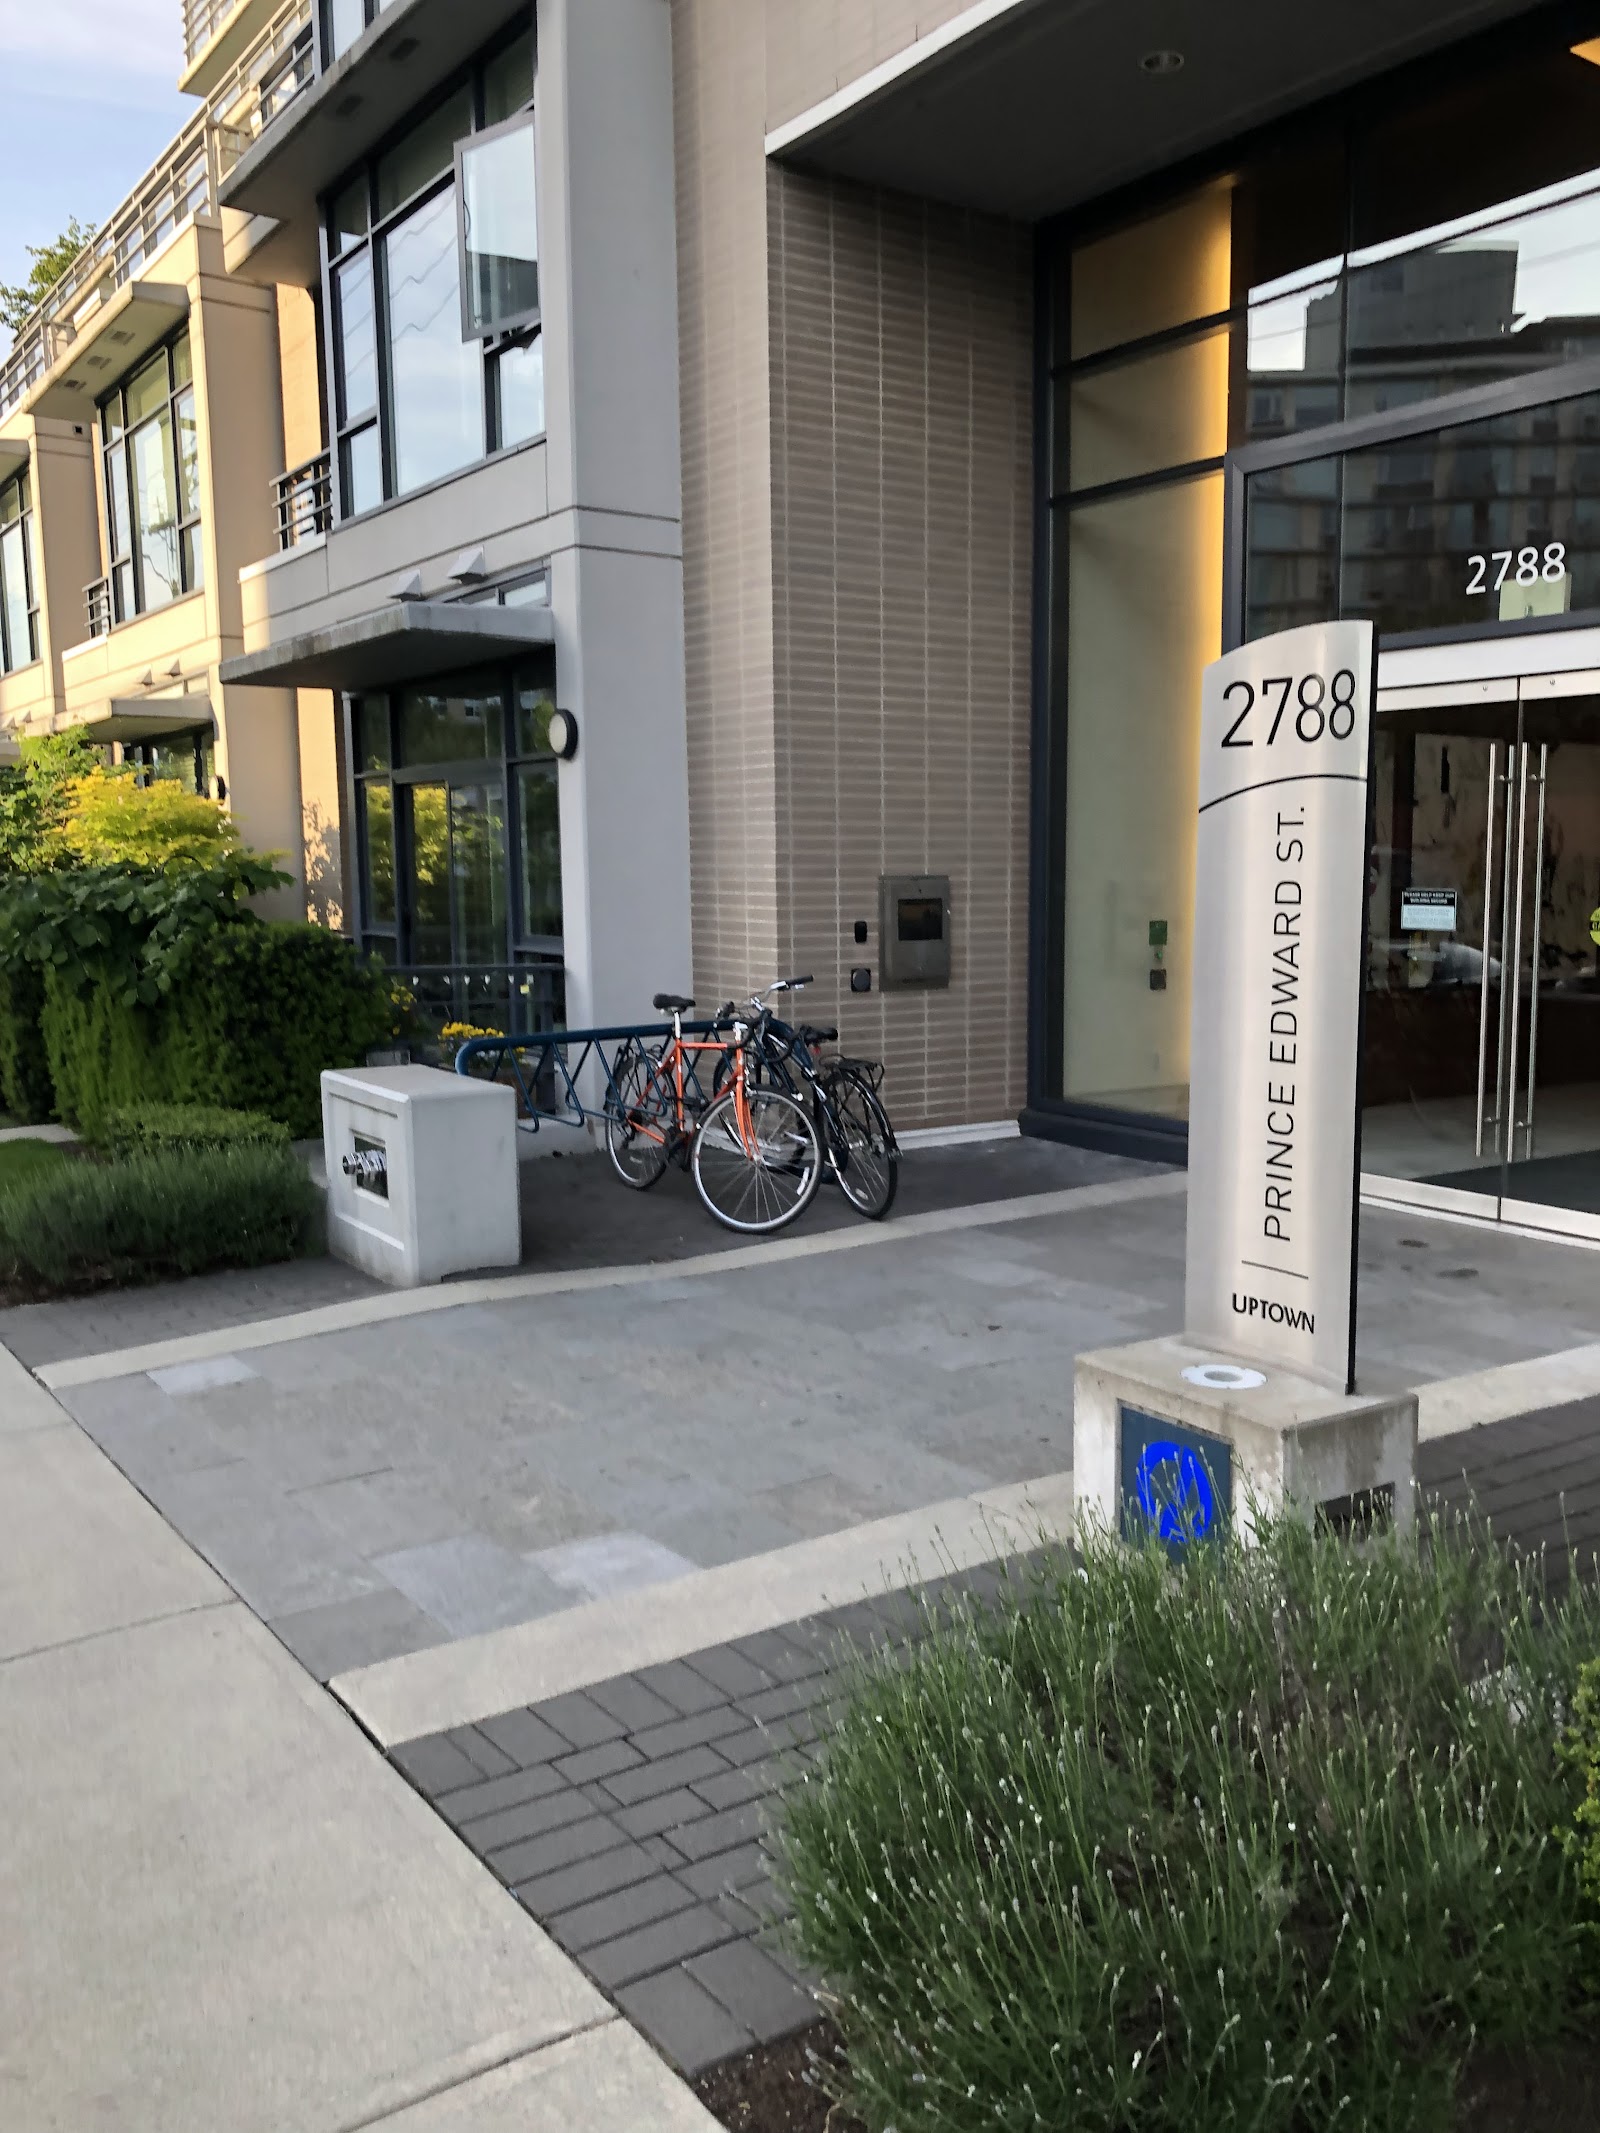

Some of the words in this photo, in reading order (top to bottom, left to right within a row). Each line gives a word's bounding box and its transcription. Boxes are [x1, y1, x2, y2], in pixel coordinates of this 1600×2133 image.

[1465, 542, 1566, 595] 2788
[1221, 669, 1355, 748] 2788
[1276, 808, 1304, 862] ST.
[1270, 881, 1301, 1064] EDWARD
[1264, 1082, 1295, 1241] PRINCE
[1233, 1293, 1314, 1334] UPTOWN
